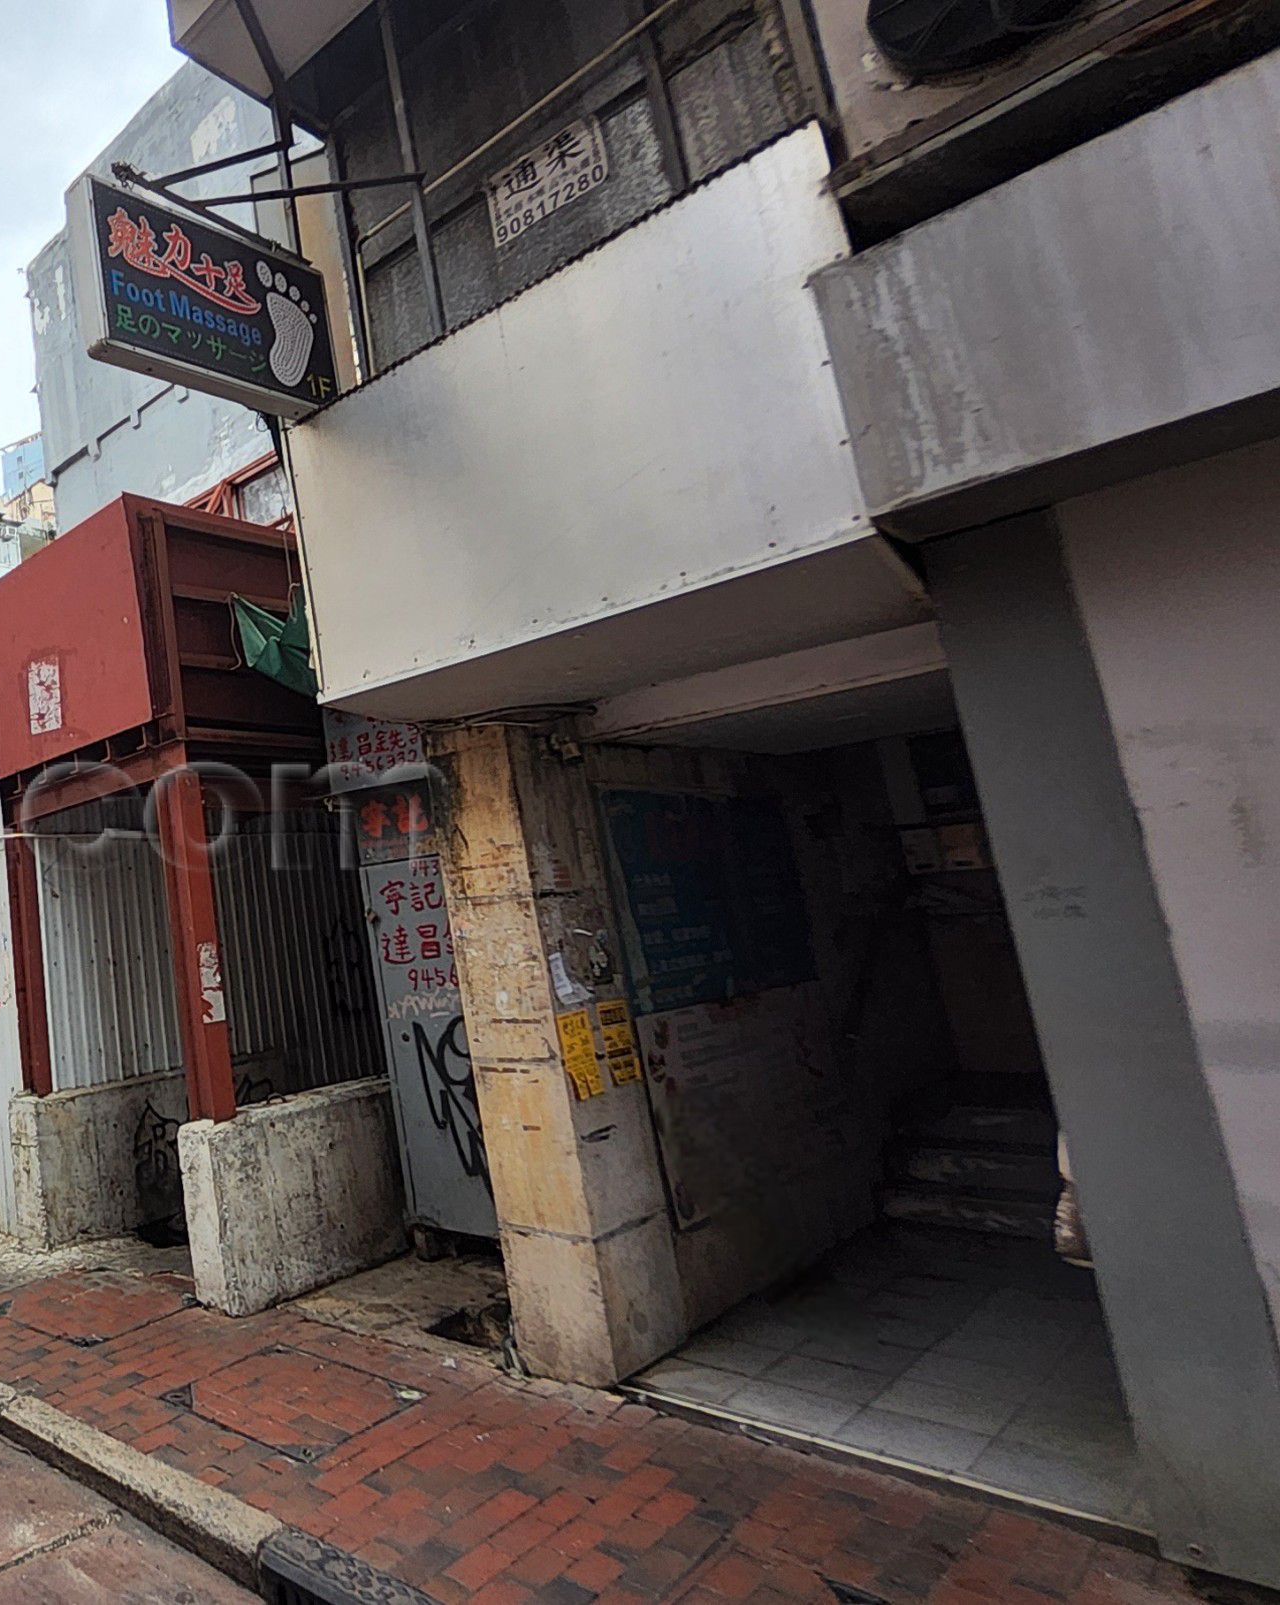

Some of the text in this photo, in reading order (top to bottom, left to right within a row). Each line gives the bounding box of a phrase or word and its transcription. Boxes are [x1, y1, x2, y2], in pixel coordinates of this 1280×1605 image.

[496, 164, 604, 243] 90817280
[502, 129, 586, 201] 通渠
[106, 206, 262, 315] 魅力十足
[111, 268, 263, 347] Foot Massage
[306, 373, 332, 399] 1F
